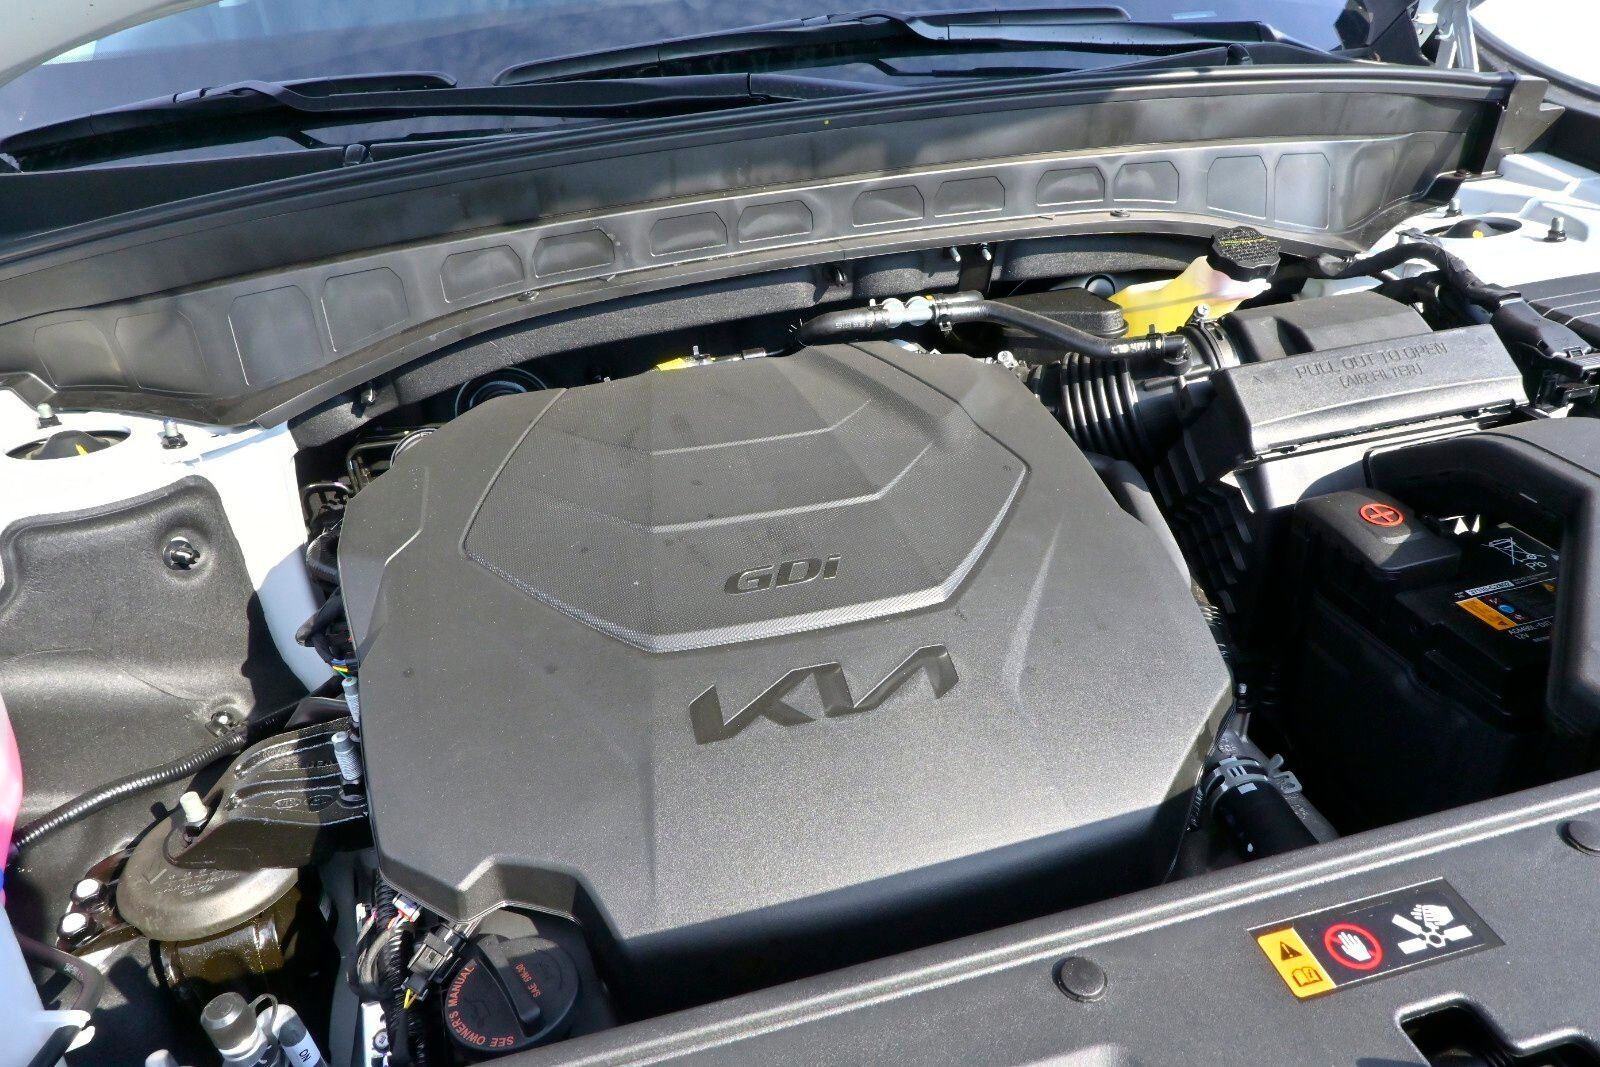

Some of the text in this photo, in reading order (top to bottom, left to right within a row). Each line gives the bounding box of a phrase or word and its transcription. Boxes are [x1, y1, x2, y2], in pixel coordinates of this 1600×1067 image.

[1295, 342, 1448, 379] PULL OUT TO OPEN
[1339, 363, 1423, 389] (AIR FILTER)
[724, 554, 841, 596] GDi
[1525, 561, 1548, 571] Pb
[689, 644, 960, 746] KIA
[448, 966, 515, 1048] SEE OWNER'S MANUAL
[527, 981, 541, 998] SAE
